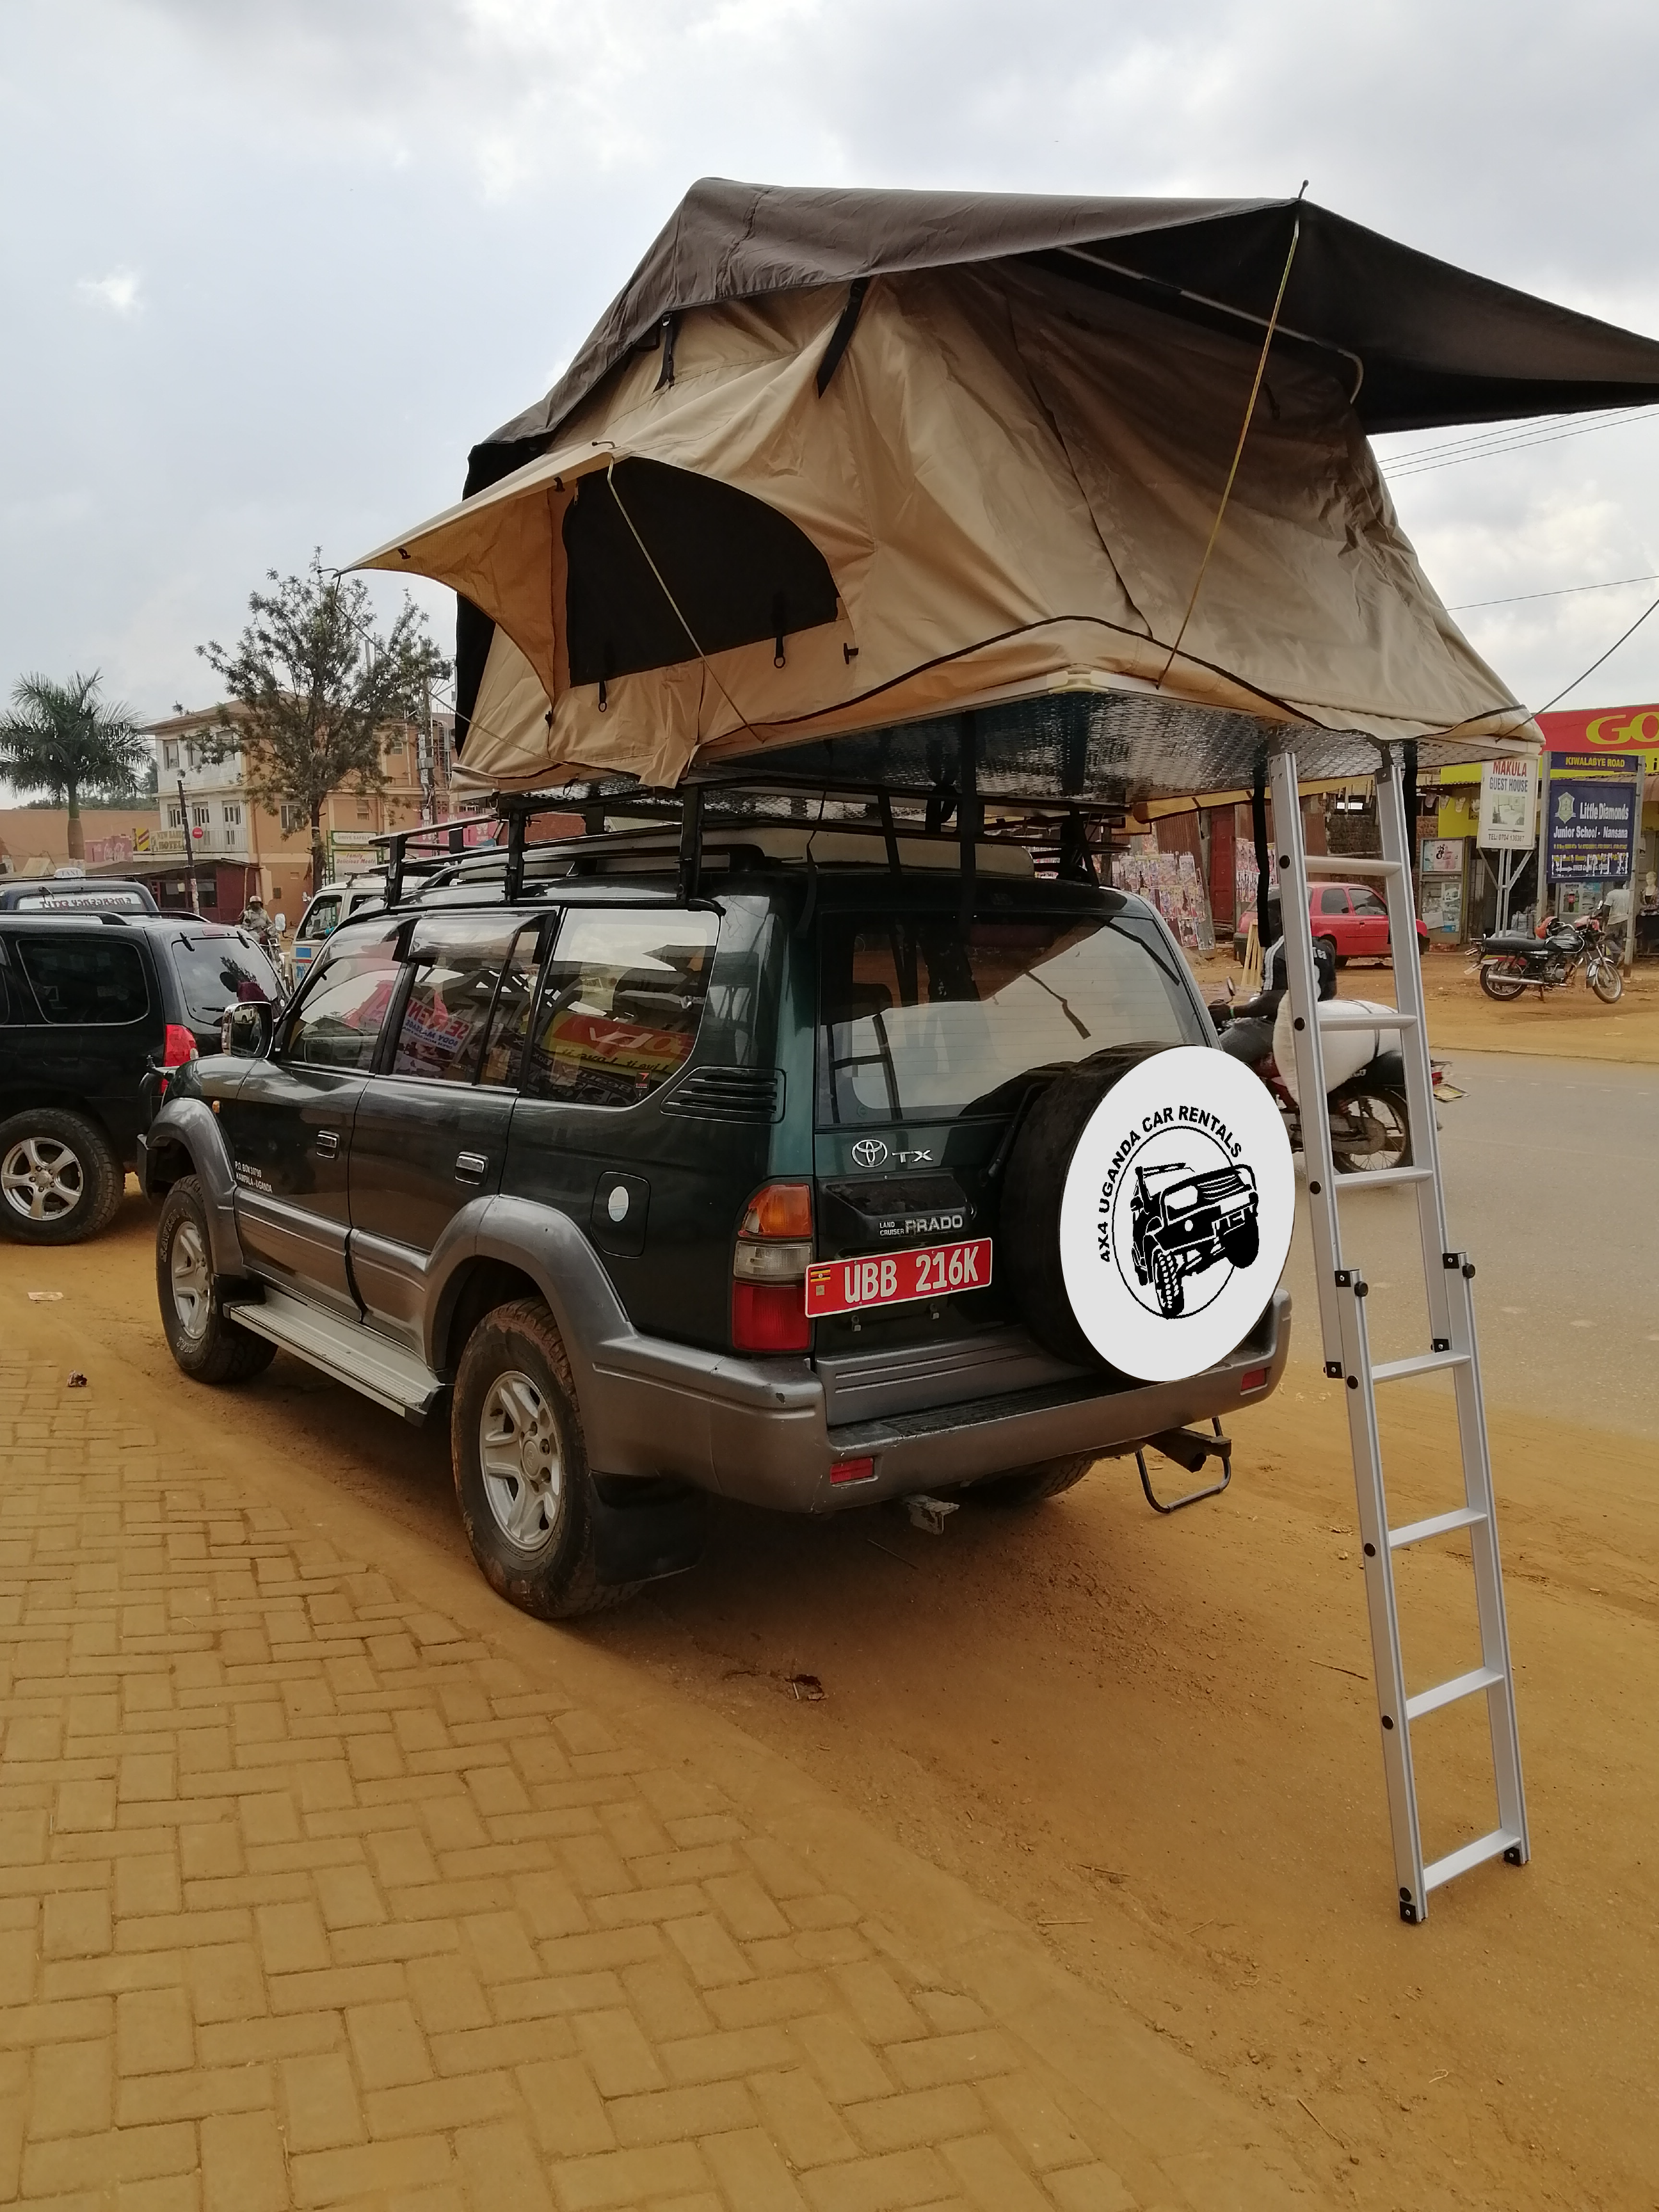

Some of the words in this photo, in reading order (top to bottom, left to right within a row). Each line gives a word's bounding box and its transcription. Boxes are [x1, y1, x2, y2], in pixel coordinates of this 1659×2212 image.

[1493, 760, 1527, 777] MAKULA
[1566, 757, 1605, 766] KIWALABYE
[1607, 758, 1625, 767] ROAD
[1489, 777, 1507, 791] GUEST
[1509, 778, 1528, 792] HOUSE
[1580, 802, 1598, 819] Little
[1599, 803, 1629, 820] Diamonds
[1553, 826, 1575, 838] Junior
[1576, 826, 1598, 838] School
[1603, 826, 1628, 838] Nansana
[1142, 1107, 1174, 1132] CAR
[1178, 1105, 1242, 1158] RENTALS
[892, 1150, 933, 1163] TX
[1098, 1130, 1141, 1213] UGANDA
[236, 1172, 253, 1186] KAMPALA
[256, 1180, 273, 1193] UGANDA
[904, 1214, 963, 1235] PRADO
[1098, 1222, 1110, 1262] 4X4
[844, 1260, 897, 1303] UBB
[915, 1246, 979, 1292] 216K
